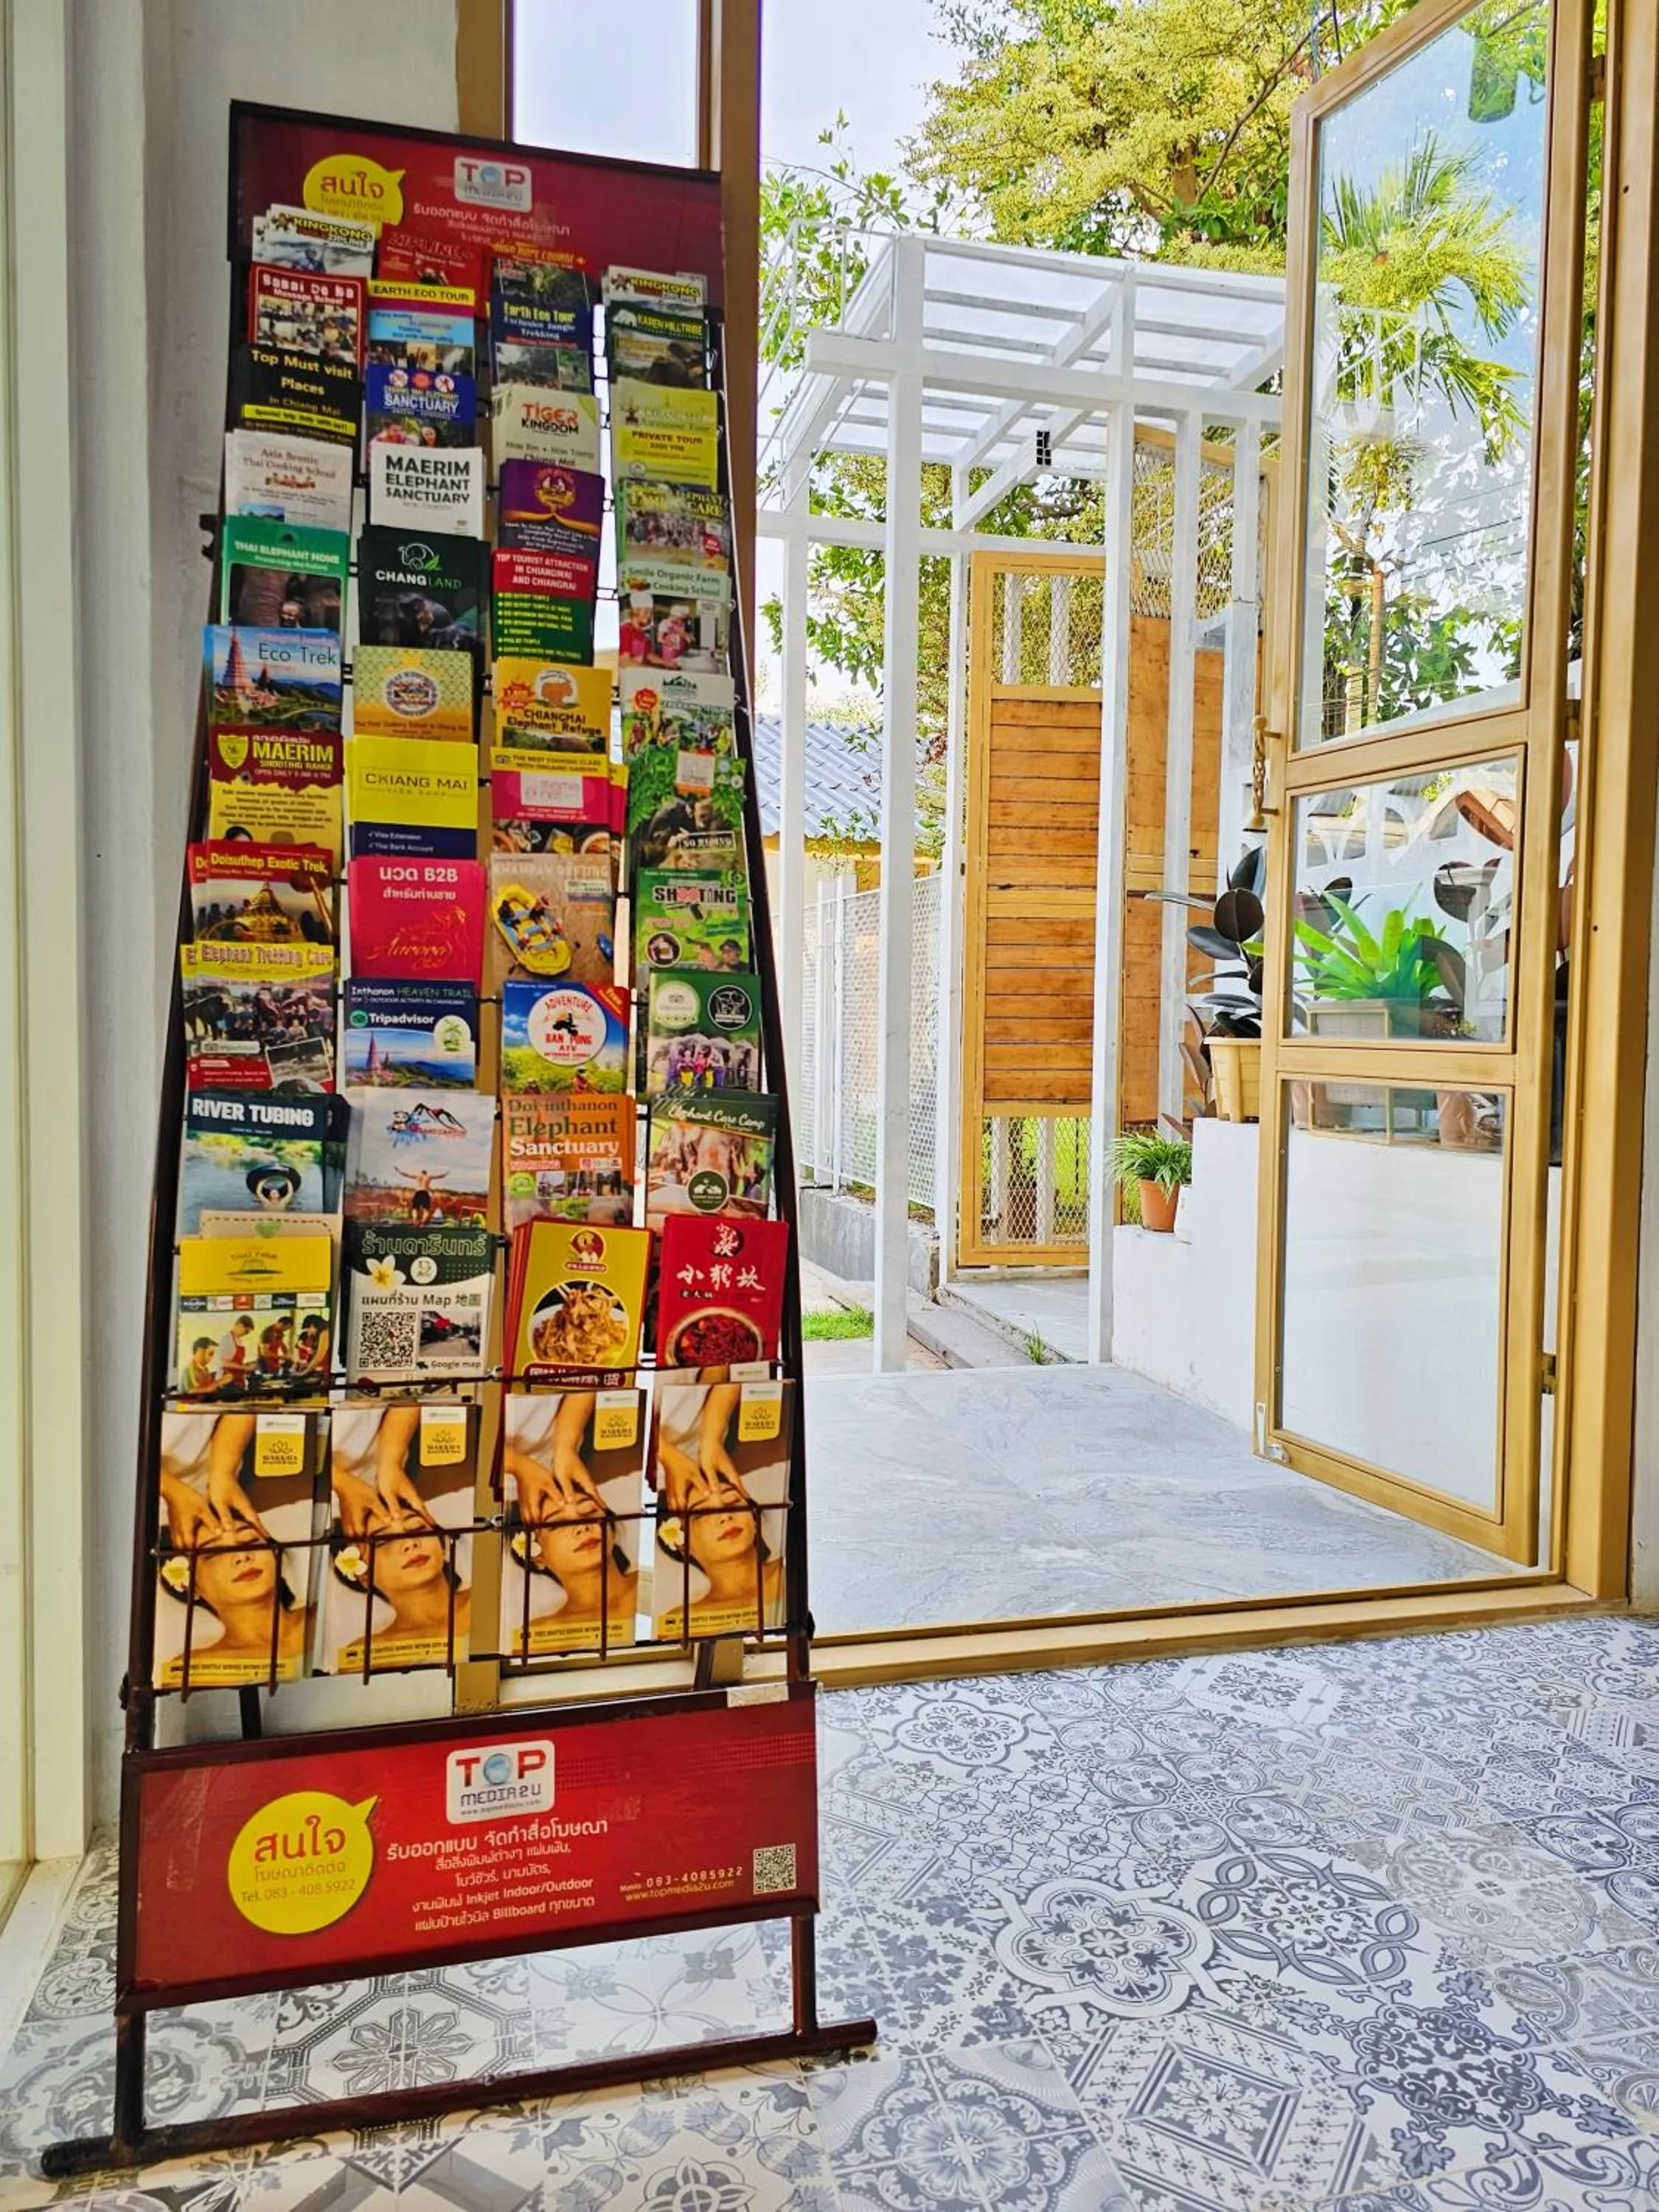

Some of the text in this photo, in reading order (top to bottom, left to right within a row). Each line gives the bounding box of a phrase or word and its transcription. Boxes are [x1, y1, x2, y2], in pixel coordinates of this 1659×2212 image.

[321, 170, 384, 199] สนใจ
[460, 161, 525, 188] TOP
[294, 217, 373, 242] KINGKONG
[374, 285, 470, 301] EARTH ECO TOUR
[504, 301, 532, 319] Earth
[554, 310, 576, 322] Tour
[251, 349, 353, 380] Top Must visit
[281, 377, 325, 395] Places
[384, 394, 460, 414] SANCTUARY
[521, 418, 579, 434] KINGDOM
[632, 430, 703, 445] PRIVATE TOUR
[243, 457, 336, 479] Thai Cooking School
[386, 454, 470, 477] MAERIM
[386, 473, 470, 490] ELEPHANT
[386, 487, 470, 504] SANCTUARY
[234, 539, 258, 552] THAI
[259, 544, 309, 560] ELEPHANT
[311, 552, 340, 565] HOME
[496, 554, 511, 563] TOP
[514, 565, 524, 573] IN
[628, 566, 721, 584] Smile Organic Farm
[512, 575, 530, 585] AND
[259, 641, 336, 664] Eco Trek
[507, 716, 602, 736] Elephant Refuge
[524, 709, 586, 724] CHIANGMAI
[252, 740, 334, 763] MAERIM
[437, 778, 468, 791] MAI
[210, 852, 265, 869] Doisuthep
[267, 856, 300, 871] Exotic
[379, 866, 459, 883] นวด B2B
[350, 986, 473, 998] Inthanon HEAVEN TRAIL
[369, 1012, 436, 1026] Tripadvisor
[192, 1097, 315, 1127] RIVER TUBING
[508, 1099, 539, 1113] Doi
[668, 1105, 713, 1123] Elephant
[714, 1110, 737, 1123] Care
[509, 1116, 619, 1138] Elephant
[509, 1138, 621, 1158] Sanctuary
[422, 1294, 452, 1309] Map
[430, 1360, 460, 1369] Google
[456, 1749, 546, 1788] TOP
[254, 1814, 347, 1863] สนใจ
[386, 1835, 478, 1861] รับออกแบบ
[646, 1865, 743, 1888] 083-4085922
[241, 1890, 262, 1903] Tel.
[298, 1883, 322, 1896] 408
[324, 1877, 356, 1892] 5922
[467, 1890, 500, 1906] Inkjet
[503, 1877, 594, 1899] Indoor/Outdoor
[625, 1879, 735, 1902] www.topmedia2u.com
[493, 1901, 547, 1920] Billboard
